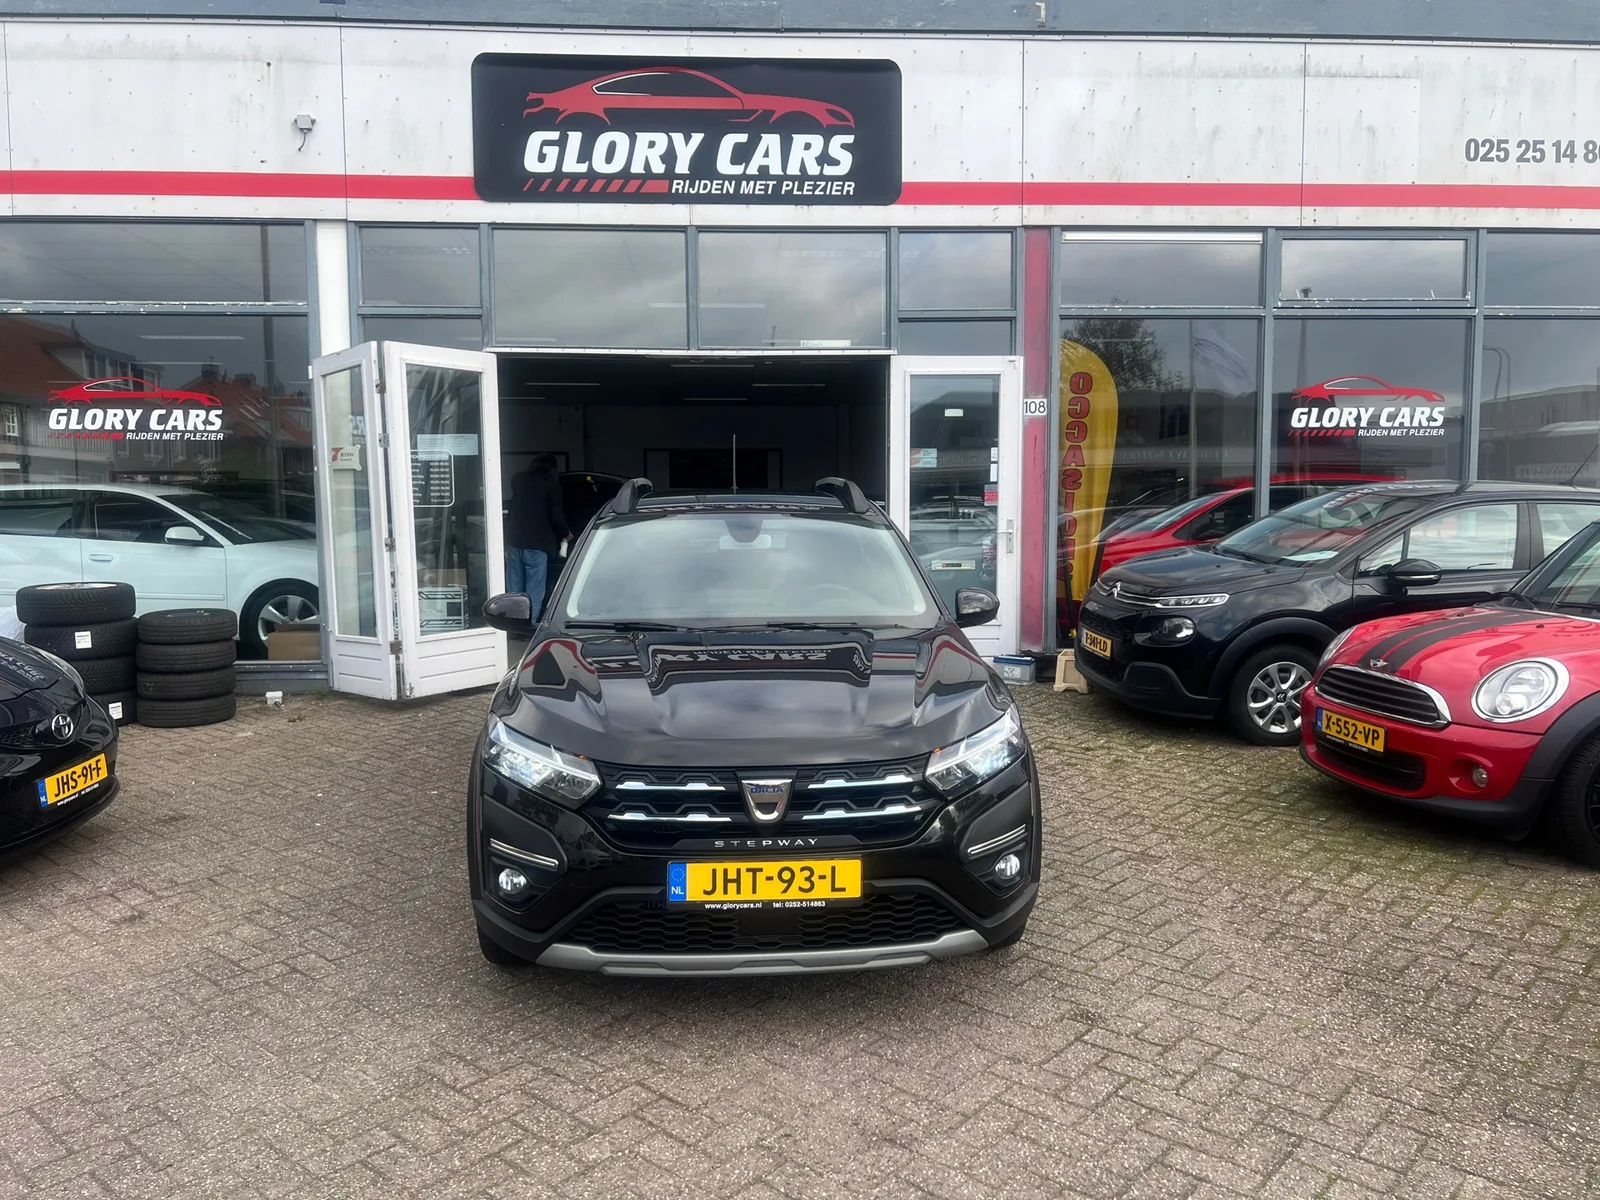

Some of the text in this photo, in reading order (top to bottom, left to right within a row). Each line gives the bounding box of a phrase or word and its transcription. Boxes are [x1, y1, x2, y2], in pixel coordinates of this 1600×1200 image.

[523, 130, 855, 176] GLORY CARS
[1465, 138, 1600, 163] 025 25 14 8
[671, 179, 855, 196] RIJDEN MET PLEZIER
[1023, 400, 1046, 414] 108
[1290, 407, 1445, 428] GLORY CARS
[48, 408, 223, 431] GLORY CARS
[126, 432, 160, 440] RIJDEN
[184, 433, 224, 441] PLEZIER
[1357, 428, 1445, 437] RIJDEN MET PLEZIER
[1325, 713, 1380, 746] X-552-VP
[54, 758, 102, 798] JHS-91-F
[714, 838, 818, 848] STEPWAY
[671, 886, 684, 895] NL
[702, 865, 847, 896] JHT-93-L
